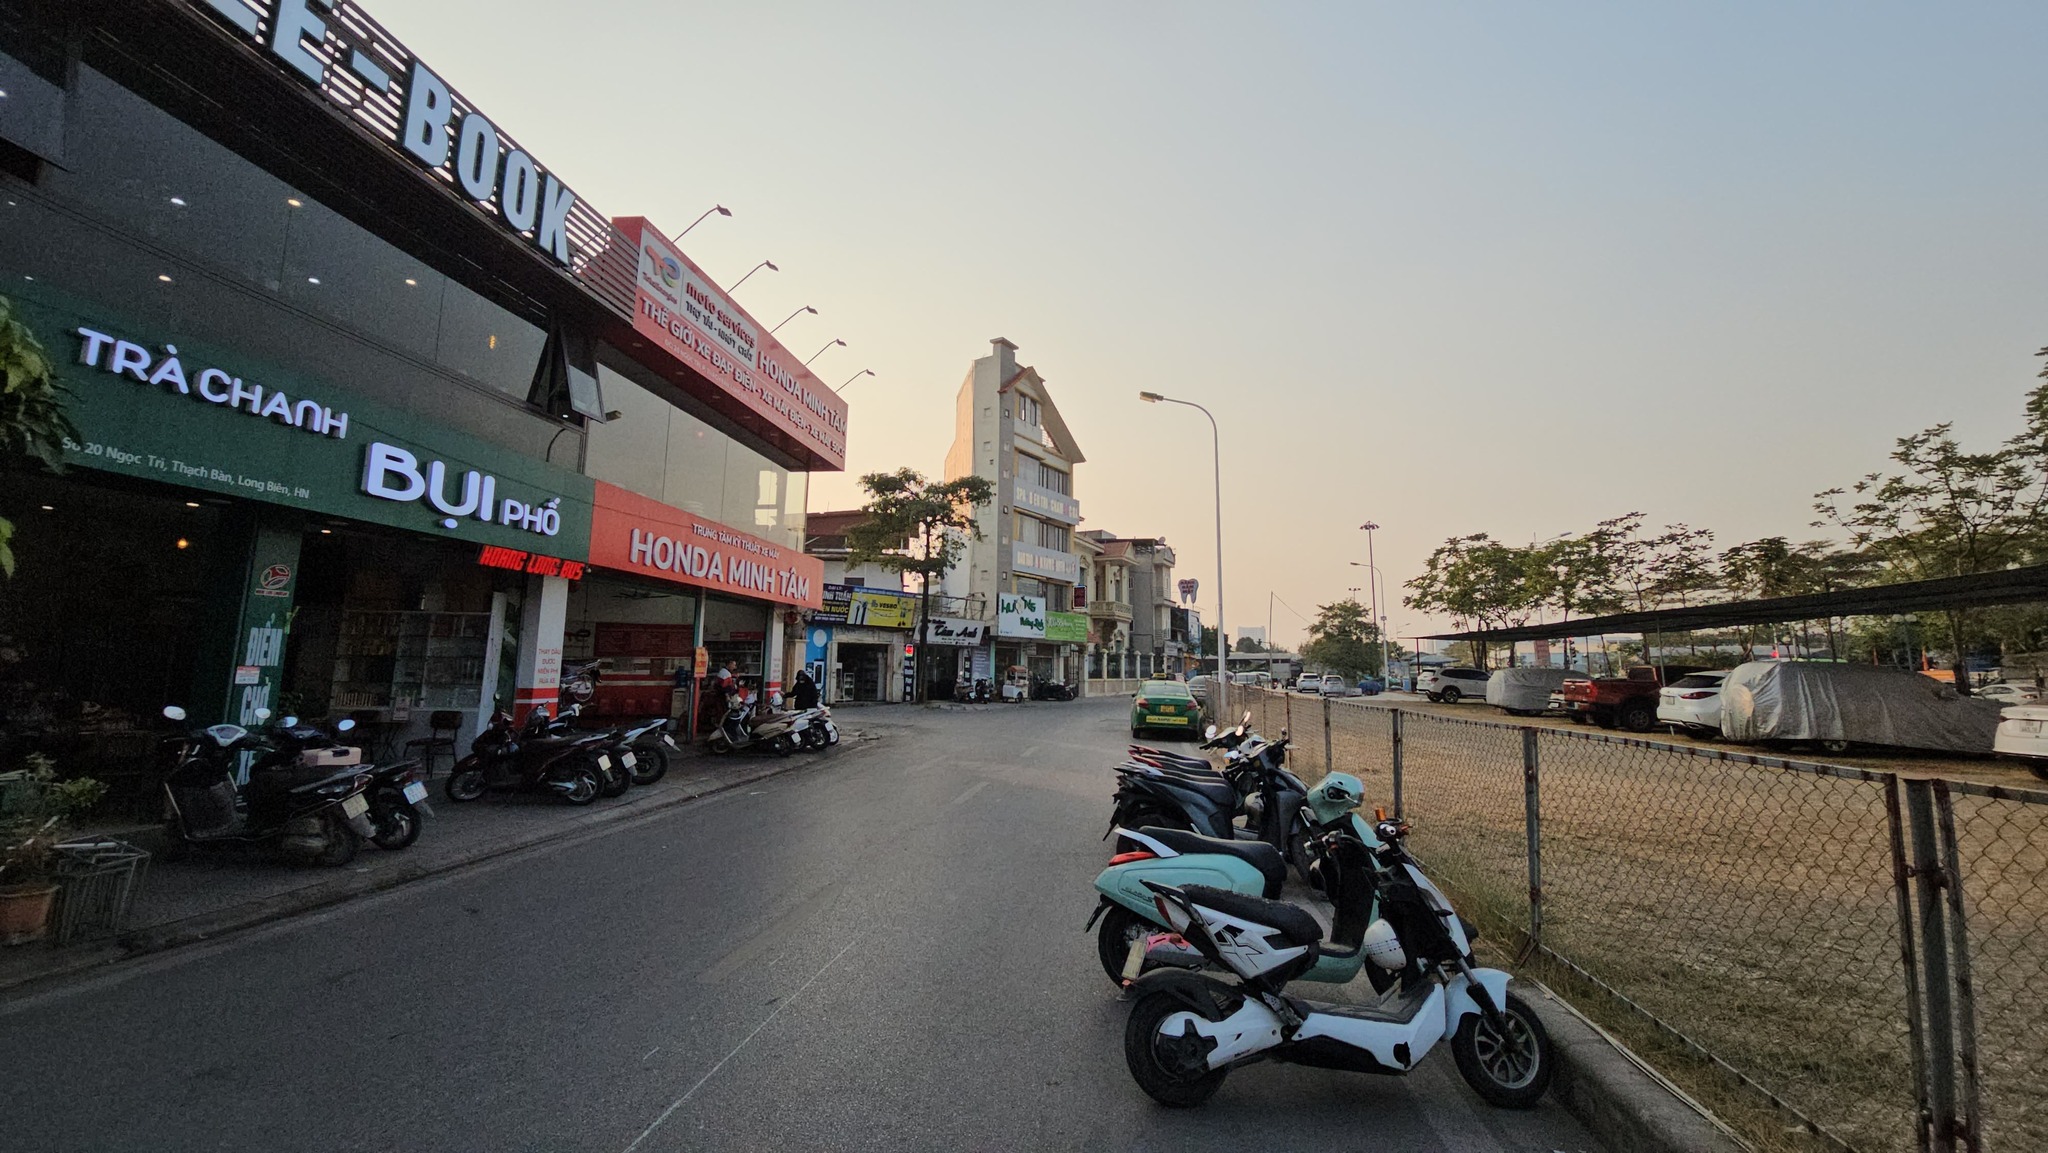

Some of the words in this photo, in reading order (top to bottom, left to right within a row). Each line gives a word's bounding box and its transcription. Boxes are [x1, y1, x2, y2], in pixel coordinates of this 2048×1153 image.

[686, 282, 716, 315] moto
[77, 327, 189, 395] TRÀ
[640, 295, 669, 330] THẾ
[669, 319, 695, 348] GIỚI
[695, 337, 712, 360] XE
[711, 349, 734, 375] ĐẠP
[733, 367, 756, 393] ĐIỆN
[758, 350, 801, 401] HONDA
[801, 387, 827, 422] MINH
[84, 441, 103, 456] 20
[106, 446, 141, 466] Ngọc
[172, 459, 208, 478] Thạch
[210, 468, 236, 486] Bàn,
[238, 474, 265, 493] Long
[266, 480, 291, 497] Biên,
[293, 485, 310, 500] HN
[362, 441, 497, 529] BỤI
[499, 496, 561, 537] PHỐ
[560, 560, 586, 581] BUS
[630, 528, 724, 584] HONDA
[728, 556, 776, 594] MINH
[778, 566, 810, 601] TÂM
[692, 522, 718, 541] TRUNG
[718, 530, 733, 546] TÂM
[741, 538, 761, 556] THUẬT
[760, 543, 769, 557] XE
